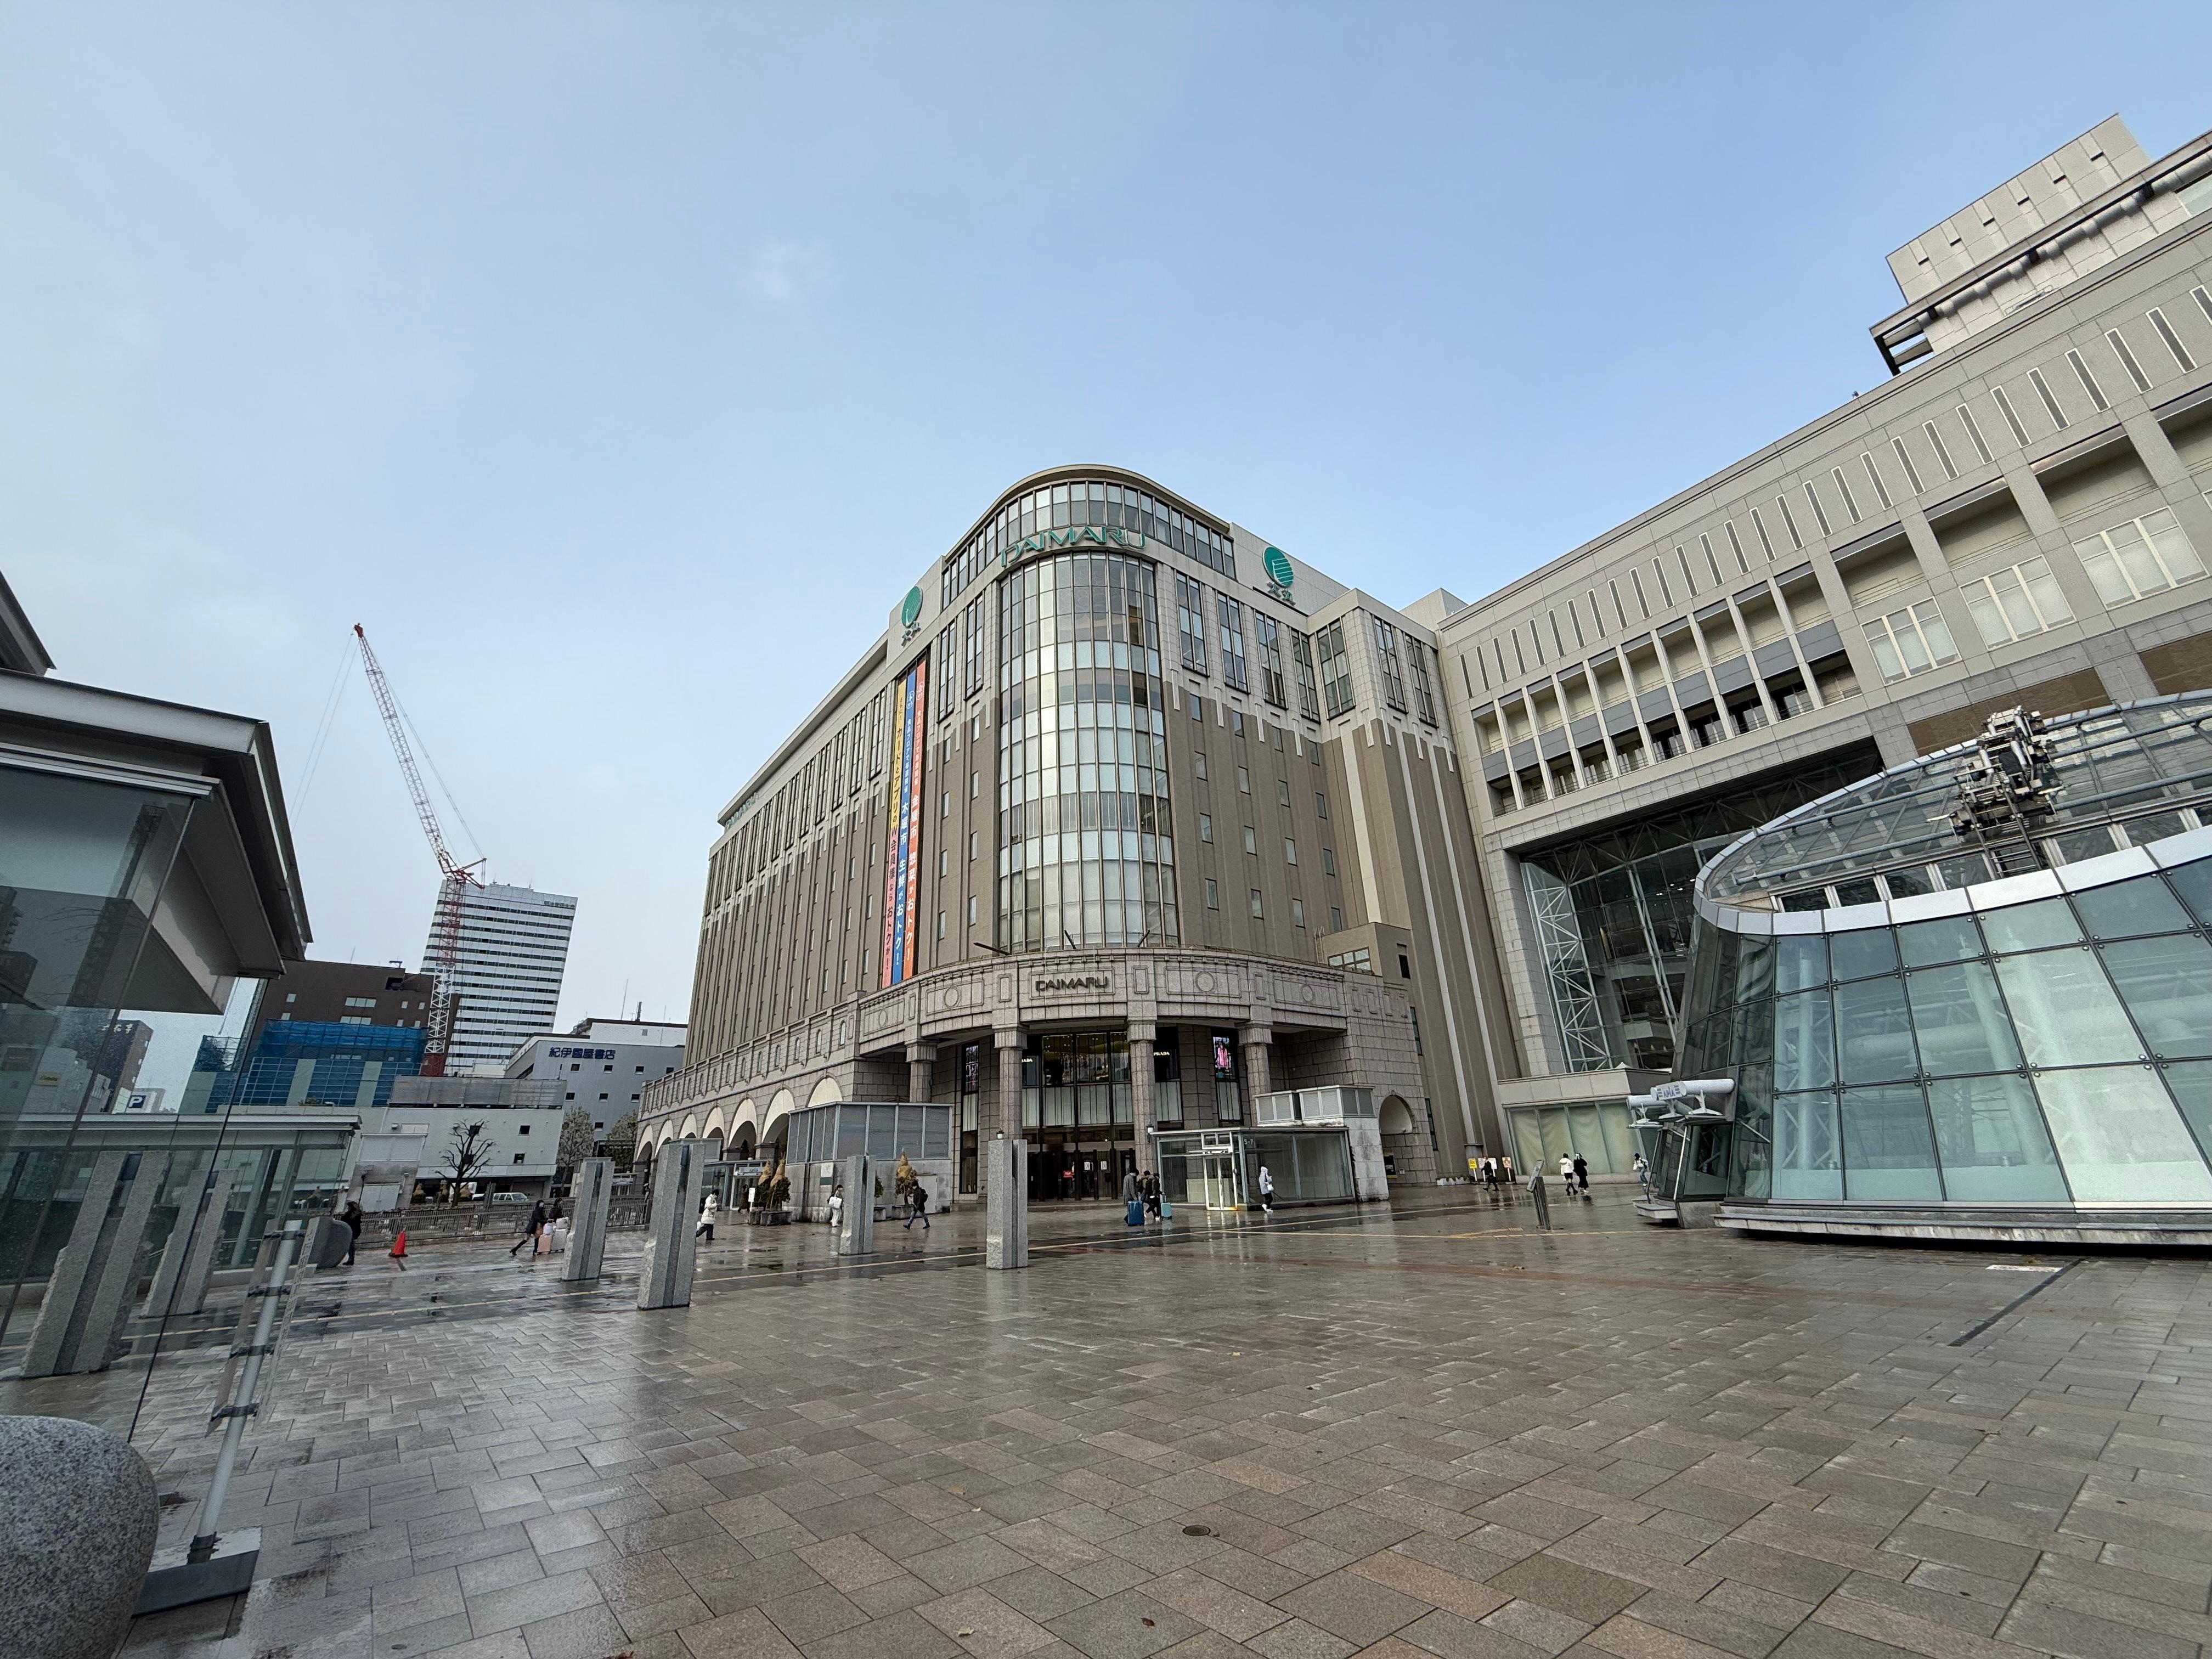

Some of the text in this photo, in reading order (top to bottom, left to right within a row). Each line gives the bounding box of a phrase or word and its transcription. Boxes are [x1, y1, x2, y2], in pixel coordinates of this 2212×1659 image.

[1000, 526, 1146, 567] DAIMARU
[1036, 977, 1107, 991] DAIMARU
[549, 1047, 616, 1059] 紀伊國屋書店
[129, 1096, 143, 1107] P
